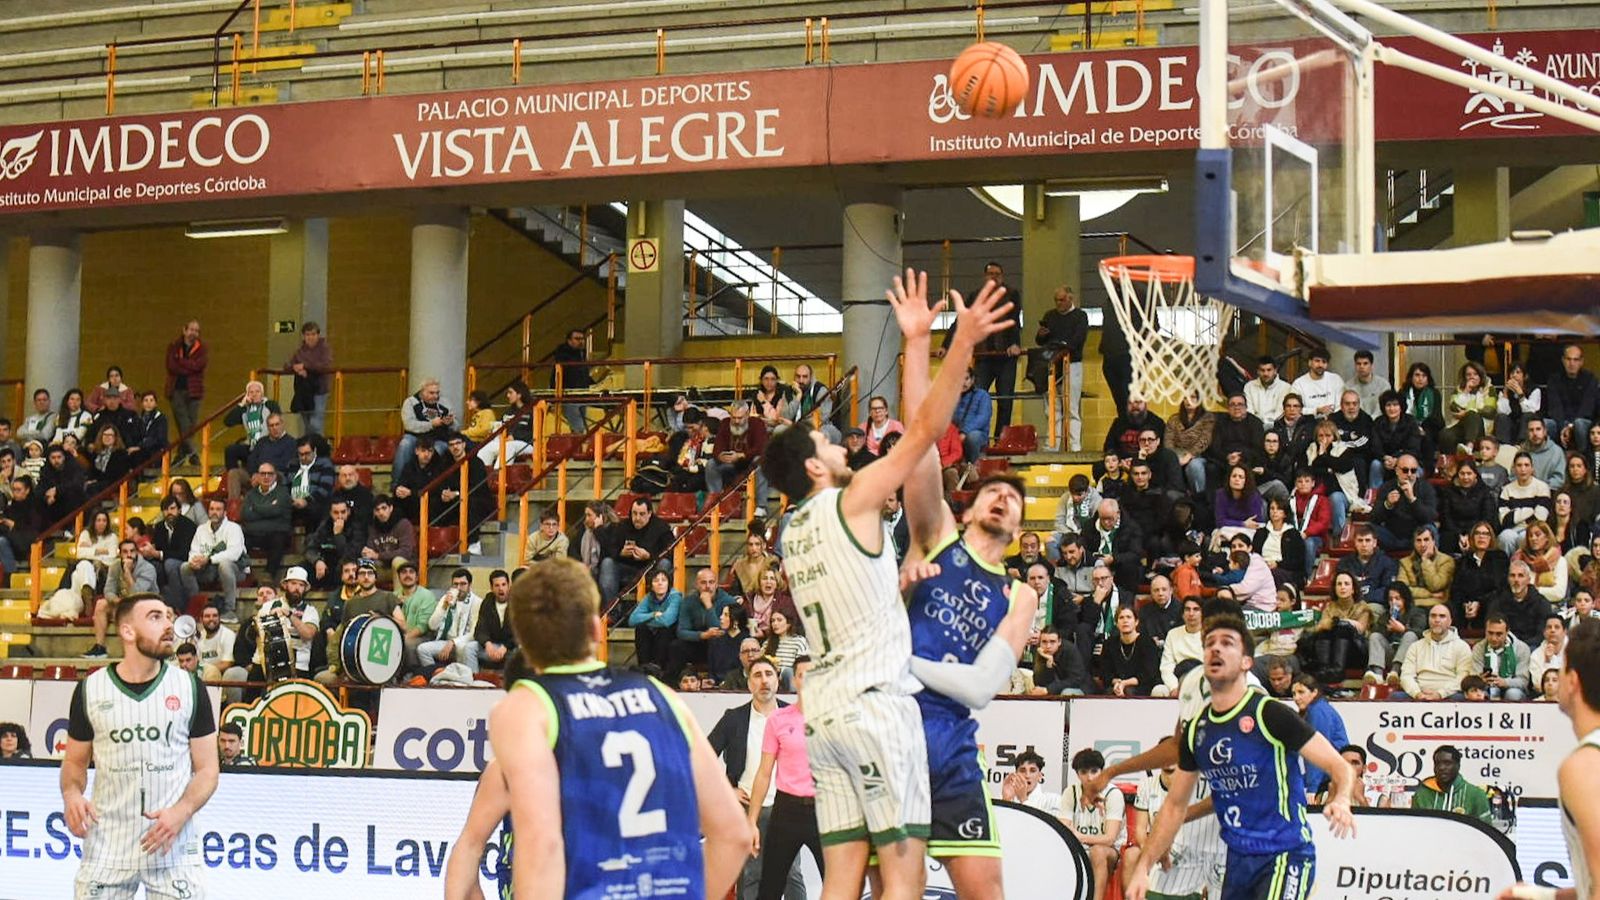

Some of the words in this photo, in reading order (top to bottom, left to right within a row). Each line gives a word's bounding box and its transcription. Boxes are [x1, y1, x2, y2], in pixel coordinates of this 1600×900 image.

[418, 97, 509, 122] PALACIO
[515, 88, 634, 116] MUNICIPAL
[640, 80, 752, 106] DEPORTES
[49, 113, 271, 178] IMDECO
[393, 125, 543, 180] VISTA
[560, 108, 785, 170] ALEGRE
[930, 133, 1003, 152] Instituto
[1007, 129, 1096, 150] Municipal
[1101, 127, 1124, 145] de
[1130, 125, 1201, 147] Deporte
[1228, 123, 1298, 140] Córda
[0, 190, 41, 207] stituto
[43, 183, 111, 204] Municipal
[113, 181, 132, 199] de
[135, 179, 201, 200] Deportes
[204, 175, 267, 193] Córdoba
[803, 601, 831, 653] 7
[1379, 710, 1415, 729] San
[1421, 710, 1483, 730] Carlos
[1488, 711, 1494, 729] I
[1500, 712, 1516, 730] &
[1520, 712, 1532, 730] II
[393, 718, 489, 772] cot
[1458, 745, 1536, 761] staciones
[602, 729, 668, 838] 2
[1480, 763, 1501, 778] de
[0, 810, 84, 861] E.S
[202, 829, 278, 871] eas
[293, 822, 349, 873] de
[1336, 866, 1491, 895] Diputación
